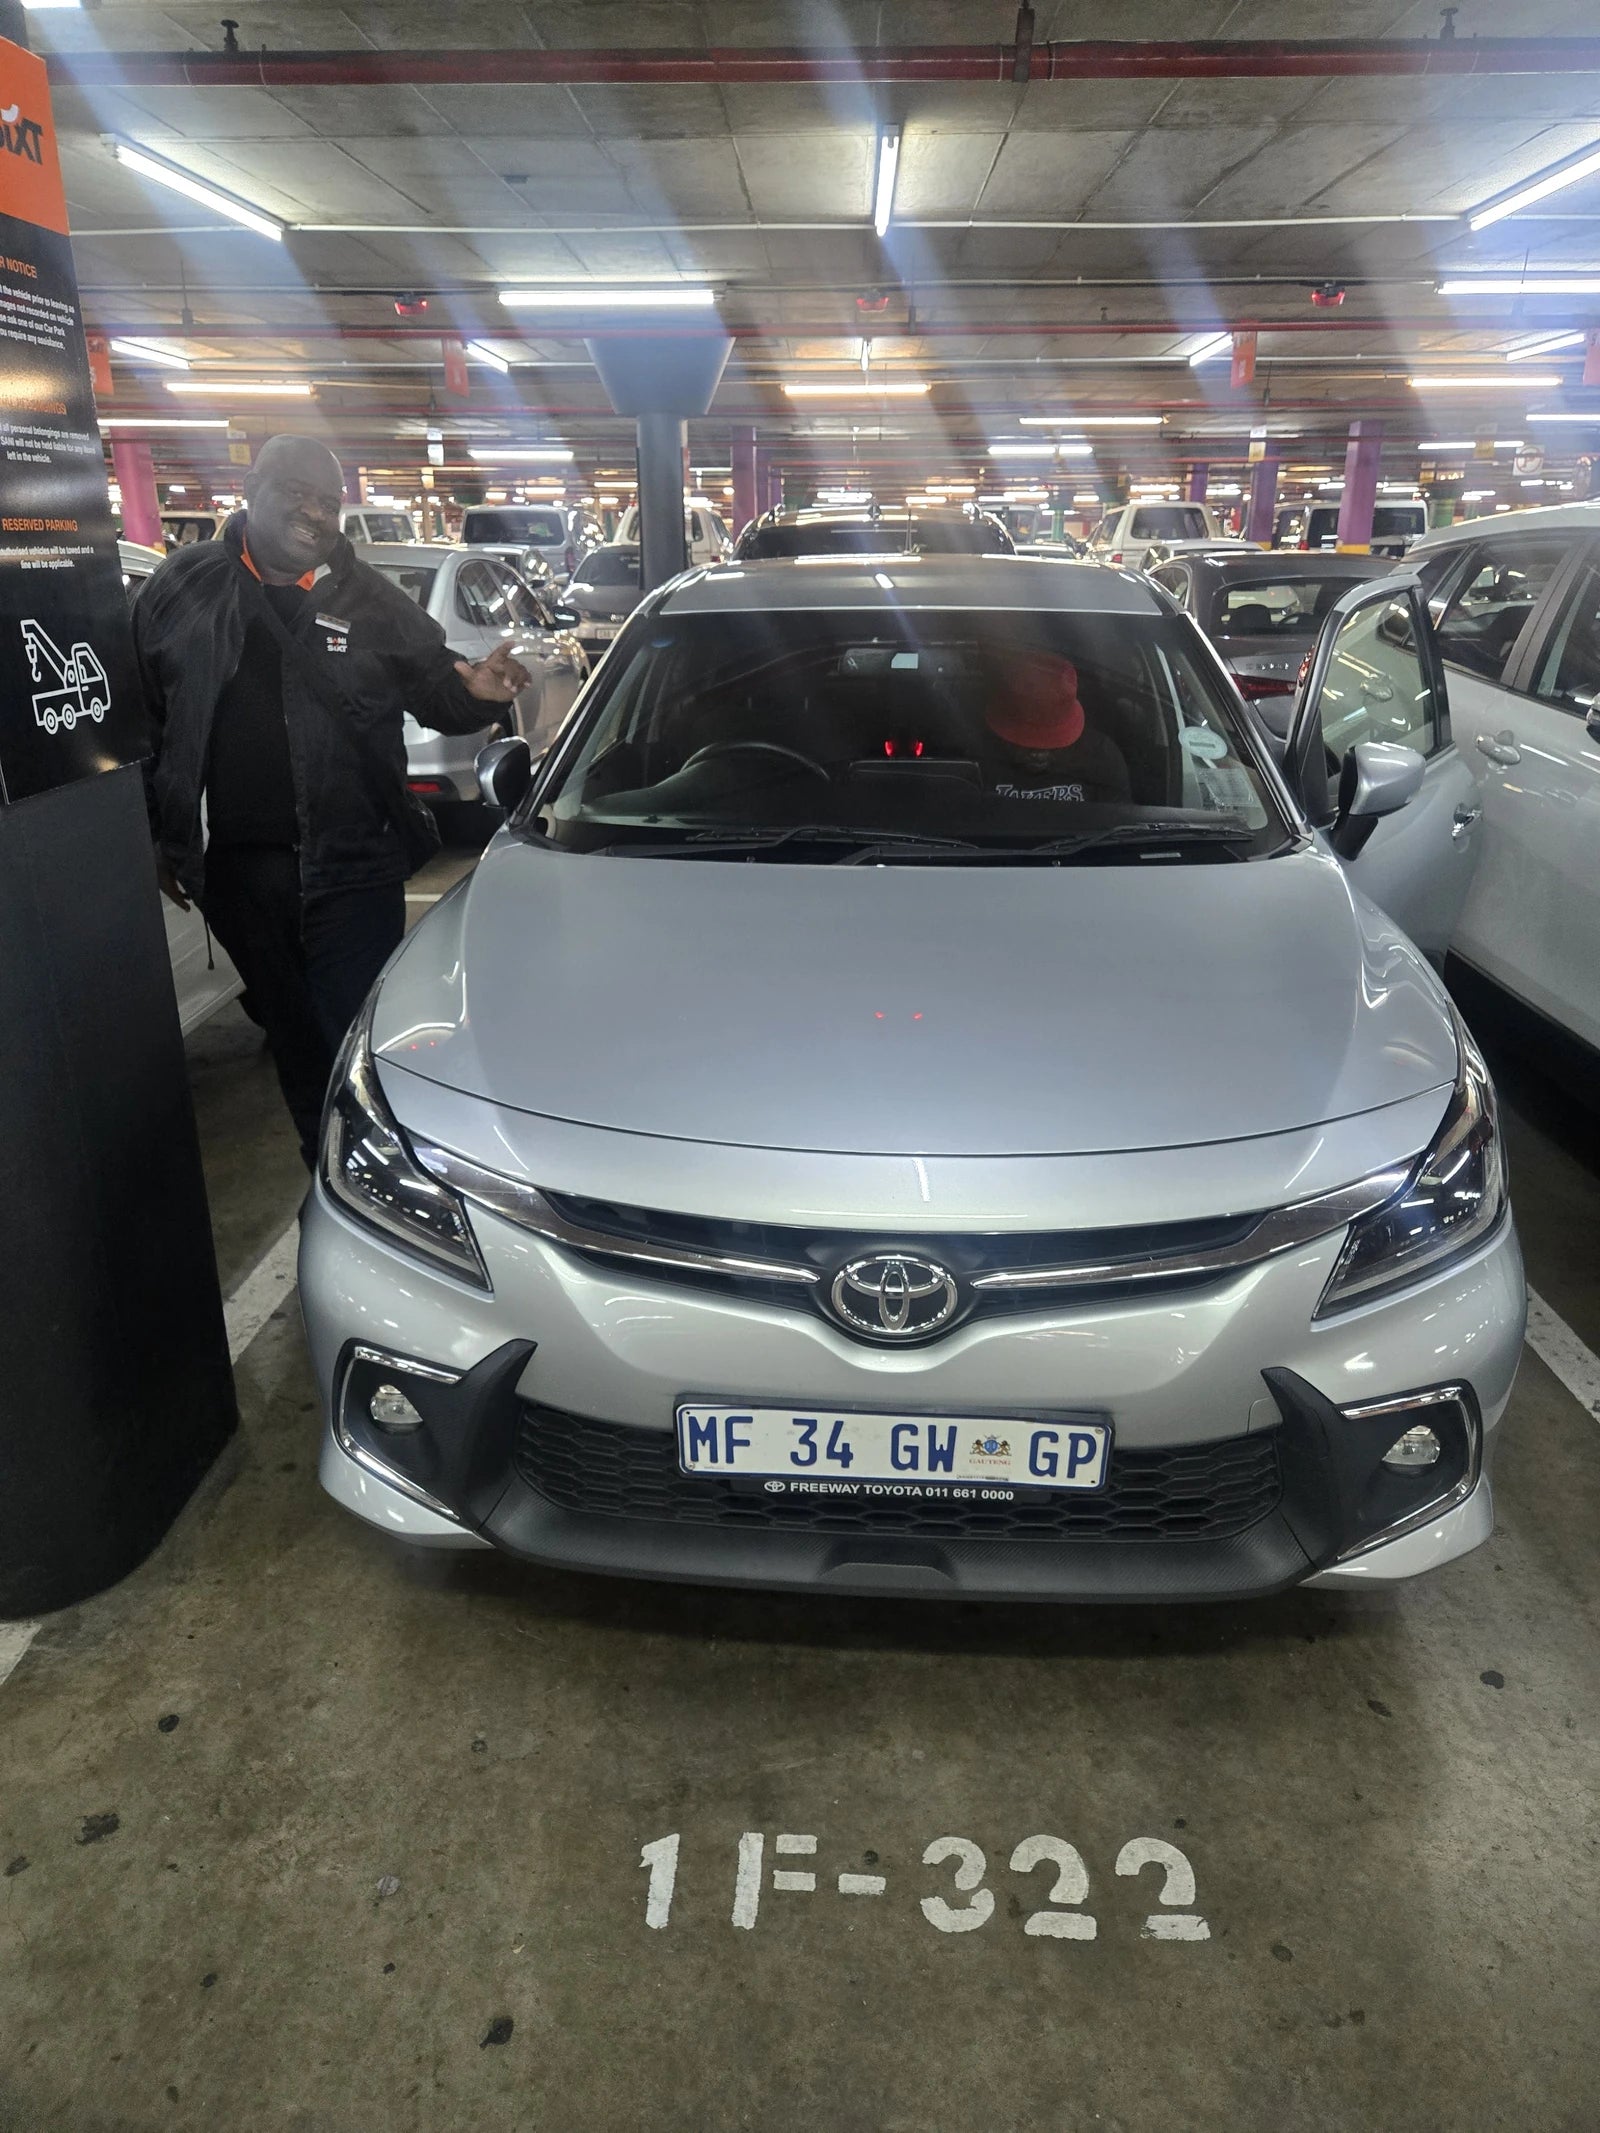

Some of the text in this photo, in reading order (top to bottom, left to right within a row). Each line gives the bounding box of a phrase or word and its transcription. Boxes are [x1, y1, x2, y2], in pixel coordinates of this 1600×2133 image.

[7, 257, 37, 279] NOTICE
[3, 285, 12, 296] the
[12, 289, 32, 301] vehicle
[32, 294, 44, 304] prior
[44, 298, 50, 307] to
[50, 299, 68, 314] leaving
[69, 305, 75, 314] as
[17, 304, 26, 314] not
[26, 307, 49, 320] recorded
[50, 313, 57, 321] on
[57, 314, 74, 326] vehicle
[7, 315, 17, 325] ask
[18, 318, 28, 328] one
[28, 320, 34, 329] of
[44, 323, 53, 334] Car
[53, 325, 65, 337] Park
[8, 330, 27, 340] require
[27, 335, 37, 345] any
[10, 425, 33, 434] personal
[33, 426, 61, 439] belongings
[69, 432, 89, 441] removed
[15, 438, 24, 447] will
[25, 440, 34, 449] not
[34, 440, 41, 449] be
[41, 440, 53, 450] held
[7, 450, 17, 461] left
[16, 452, 23, 461] in
[22, 452, 32, 462] the
[2, 518, 78, 532] RESERVED PARKING
[29, 545, 50, 556] vehicles
[50, 545, 59, 555] will
[59, 546, 66, 555] be
[66, 545, 80, 555] towed
[80, 545, 90, 554] and
[20, 559, 75, 570] fine will be applicable.
[688, 1415, 1098, 1479] MF 34 GW GP
[789, 1481, 1015, 1501] FREEWAY TOYOTA 011 661 0000
